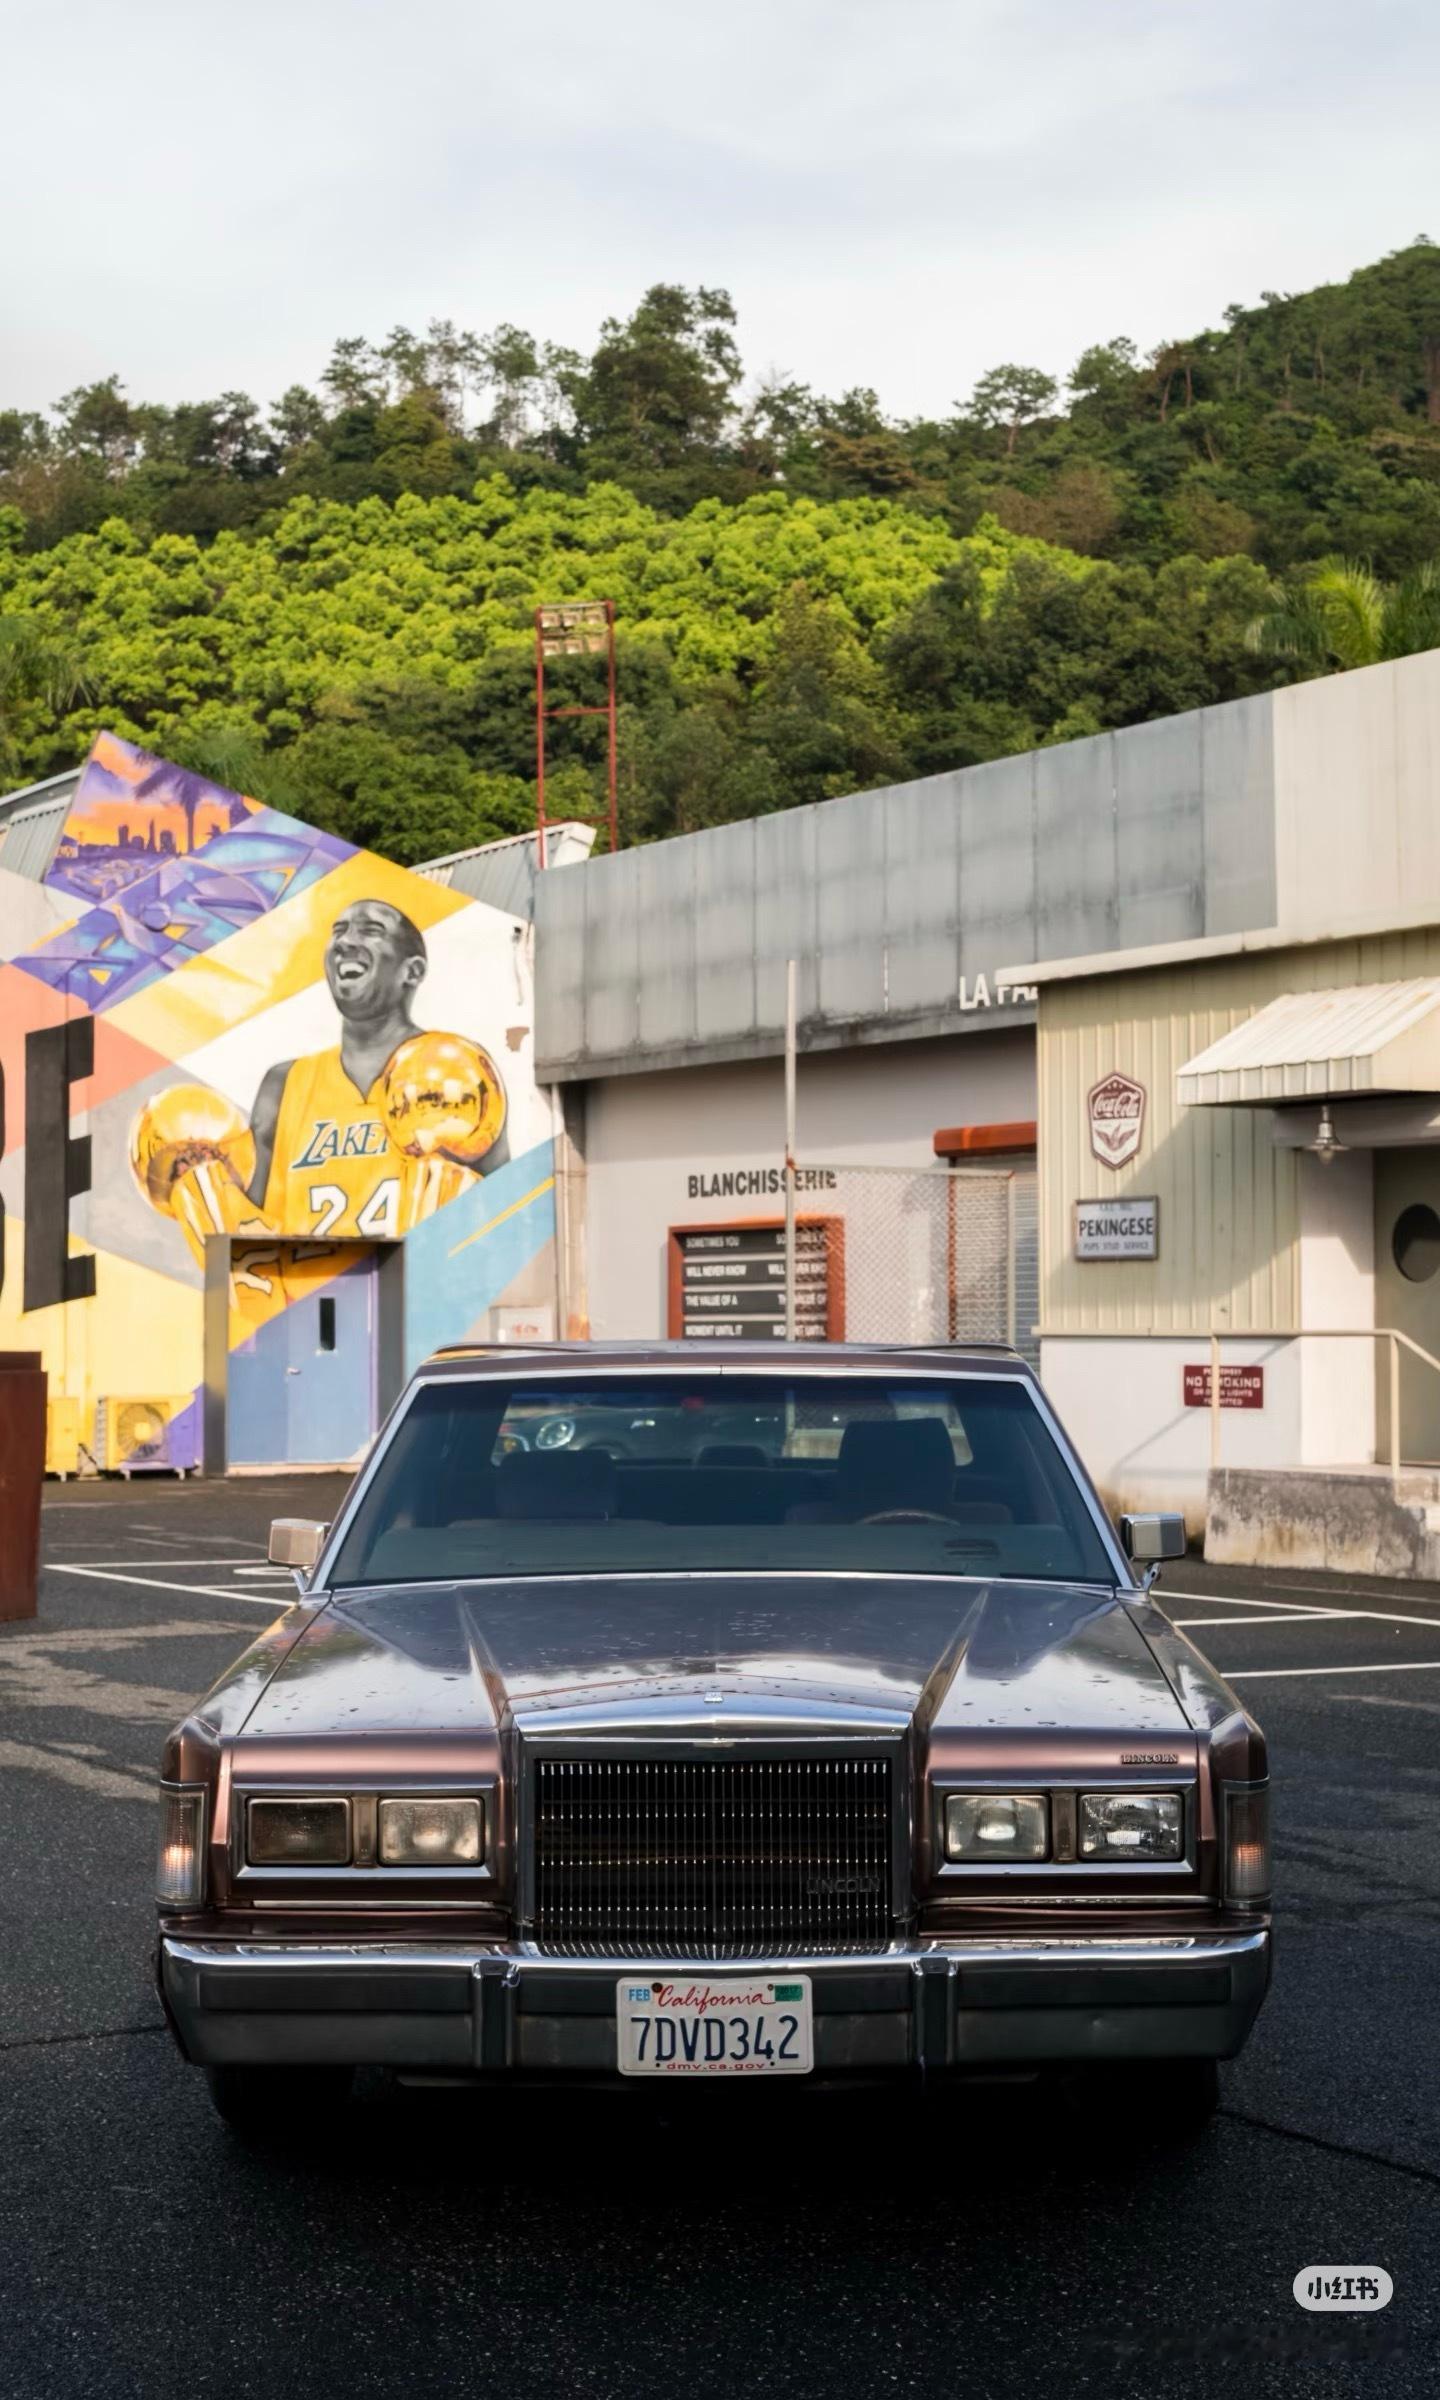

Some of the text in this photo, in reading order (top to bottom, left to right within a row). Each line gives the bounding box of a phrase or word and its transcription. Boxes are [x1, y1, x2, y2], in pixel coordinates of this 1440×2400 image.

[291, 1121, 389, 1169] LAKE
[308, 1177, 401, 1238] 24
[1078, 1217, 1154, 1237] PEKINGESE
[1186, 1376, 1203, 1387] NO
[1121, 1754, 1179, 1765] LINCOLN
[629, 1988, 650, 2001] FEB
[658, 1984, 776, 2014] California
[631, 2015, 800, 2061] 7DVD342
[666, 2061, 766, 2070] dmv.ca.gov
